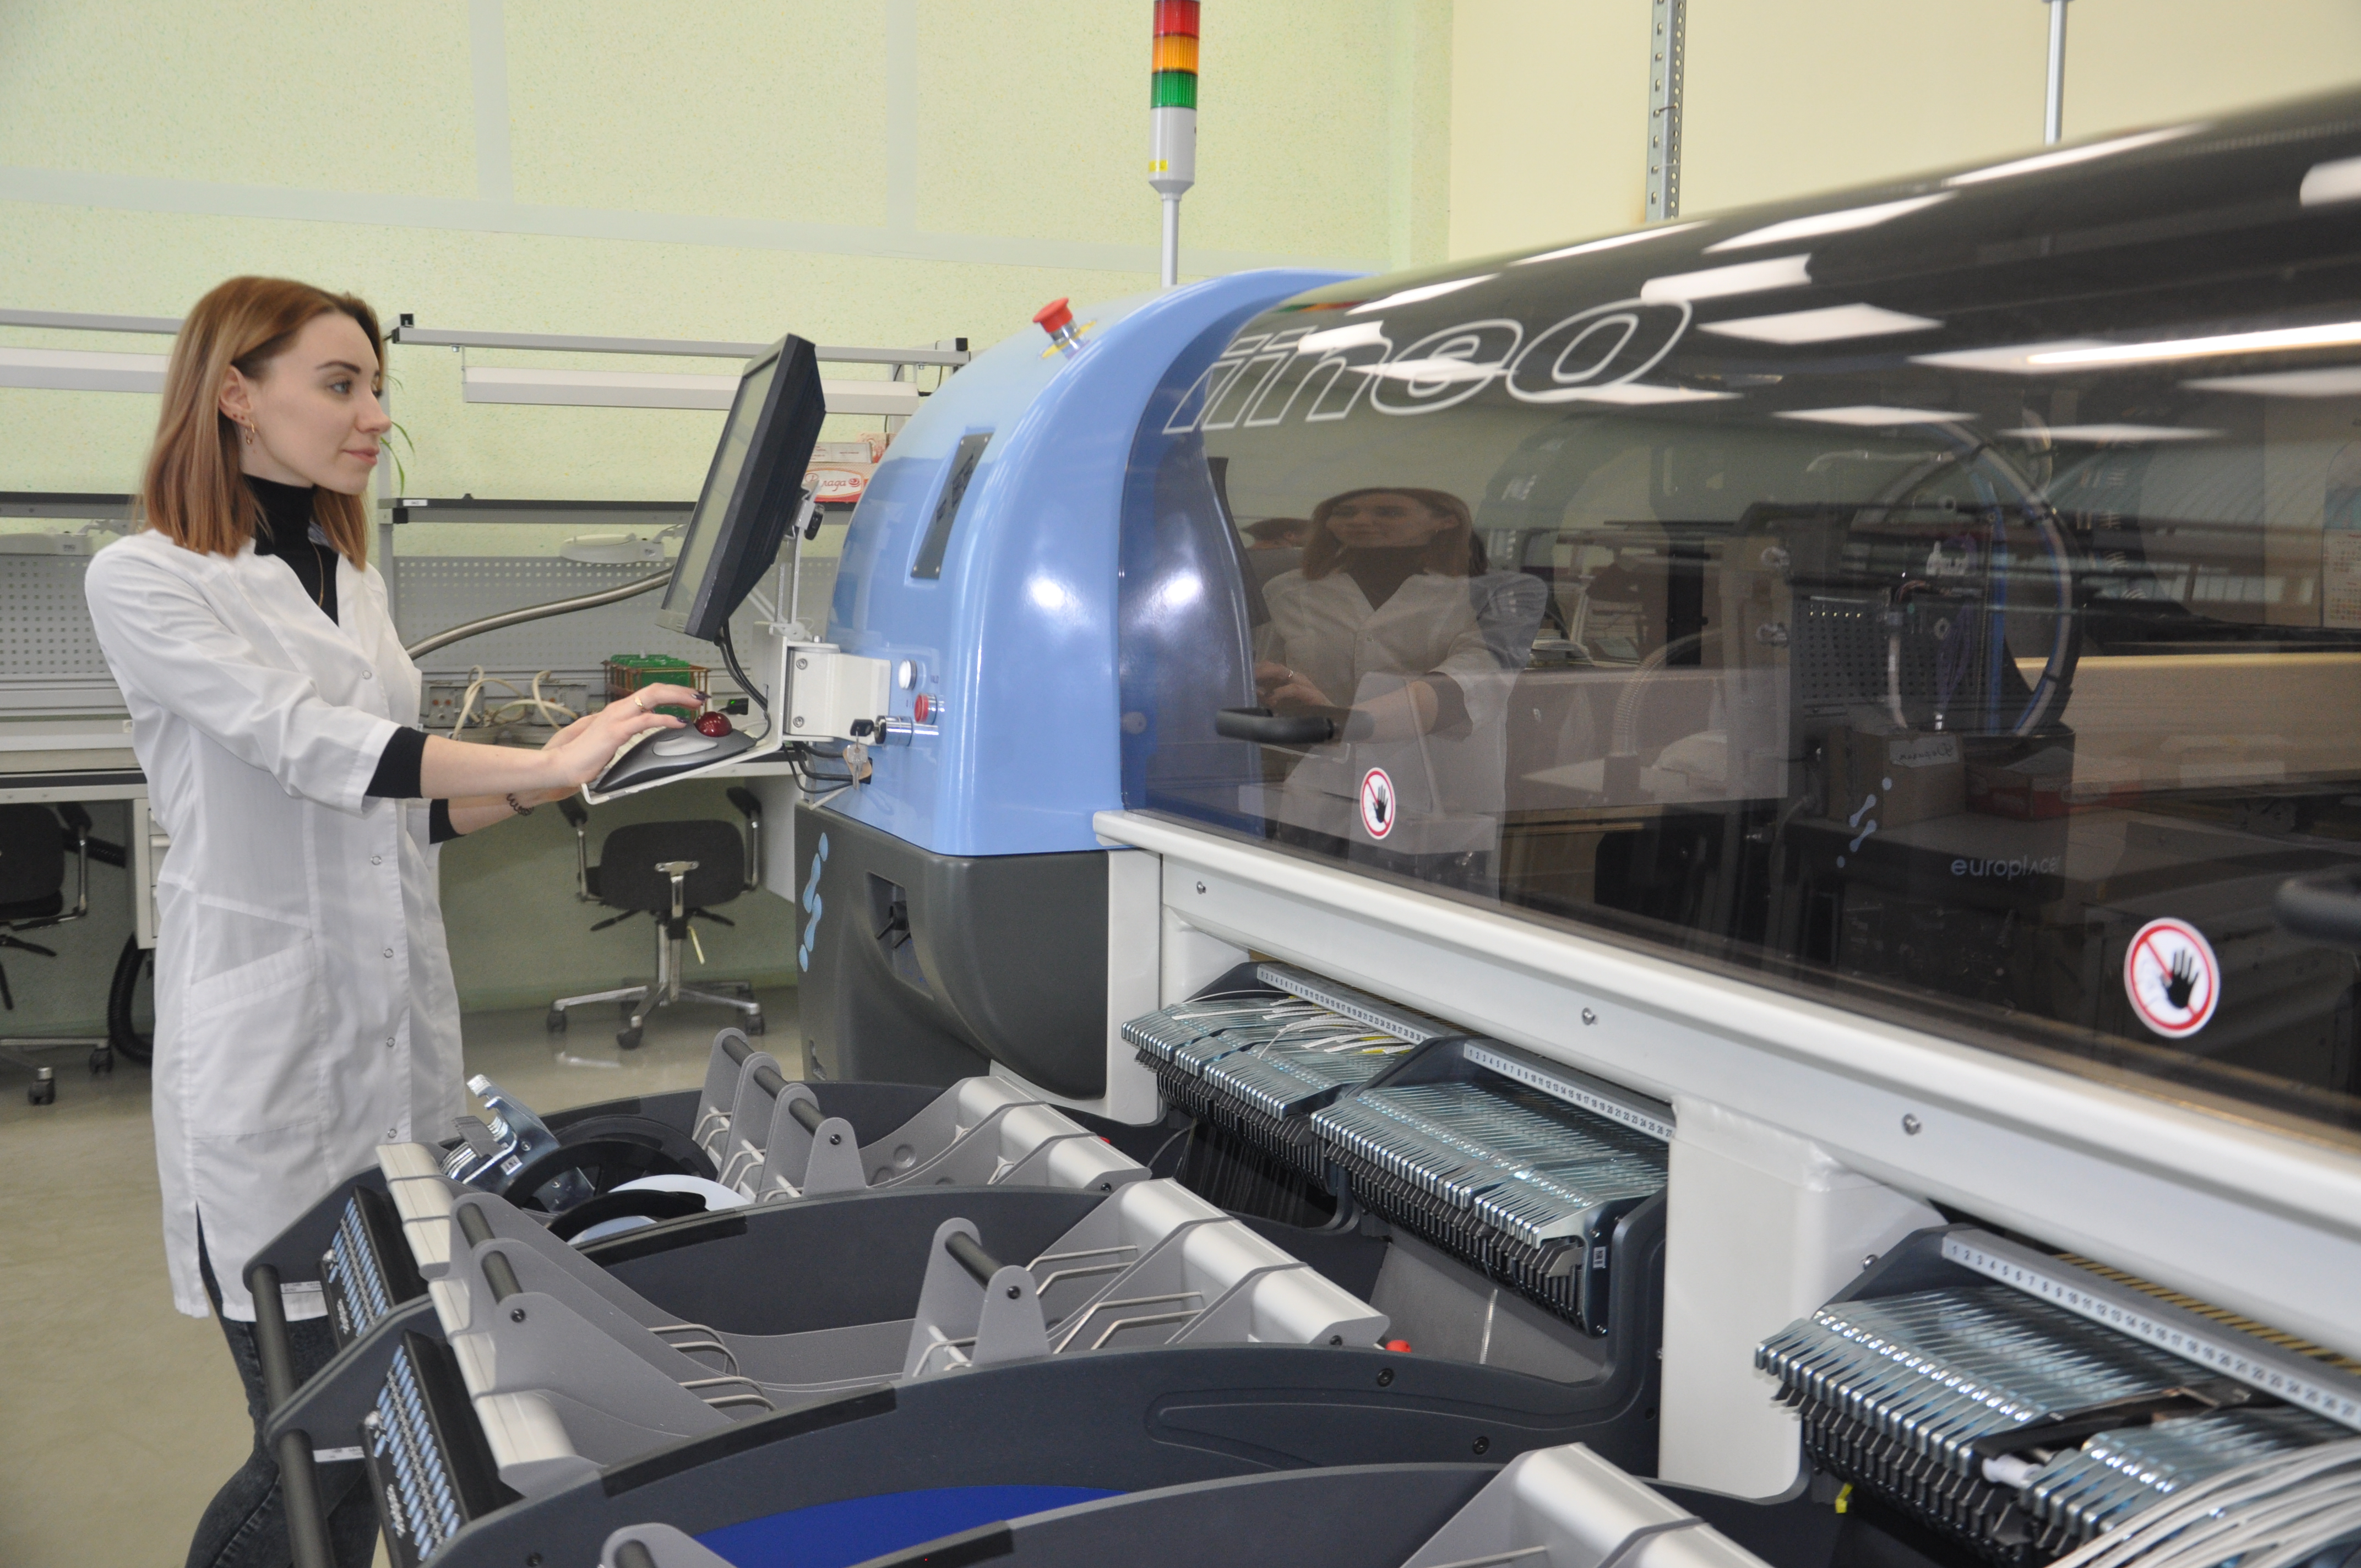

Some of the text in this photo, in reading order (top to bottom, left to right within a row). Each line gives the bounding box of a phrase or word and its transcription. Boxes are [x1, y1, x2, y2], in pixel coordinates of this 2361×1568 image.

[1496, 1060, 1500, 1068] 5
[1503, 1063, 1506, 1071] 6
[1531, 1074, 1537, 1083] 10
[1546, 1080, 1552, 1089] 12
[1553, 1083, 1559, 1092] 13
[1560, 1086, 1566, 1095] 14
[1568, 1090, 1574, 1098] 15
[1576, 1092, 1582, 1101] 16
[1584, 1096, 1590, 1104] 17
[1591, 1099, 1597, 1108] 18
[1599, 1102, 1606, 1111] 19
